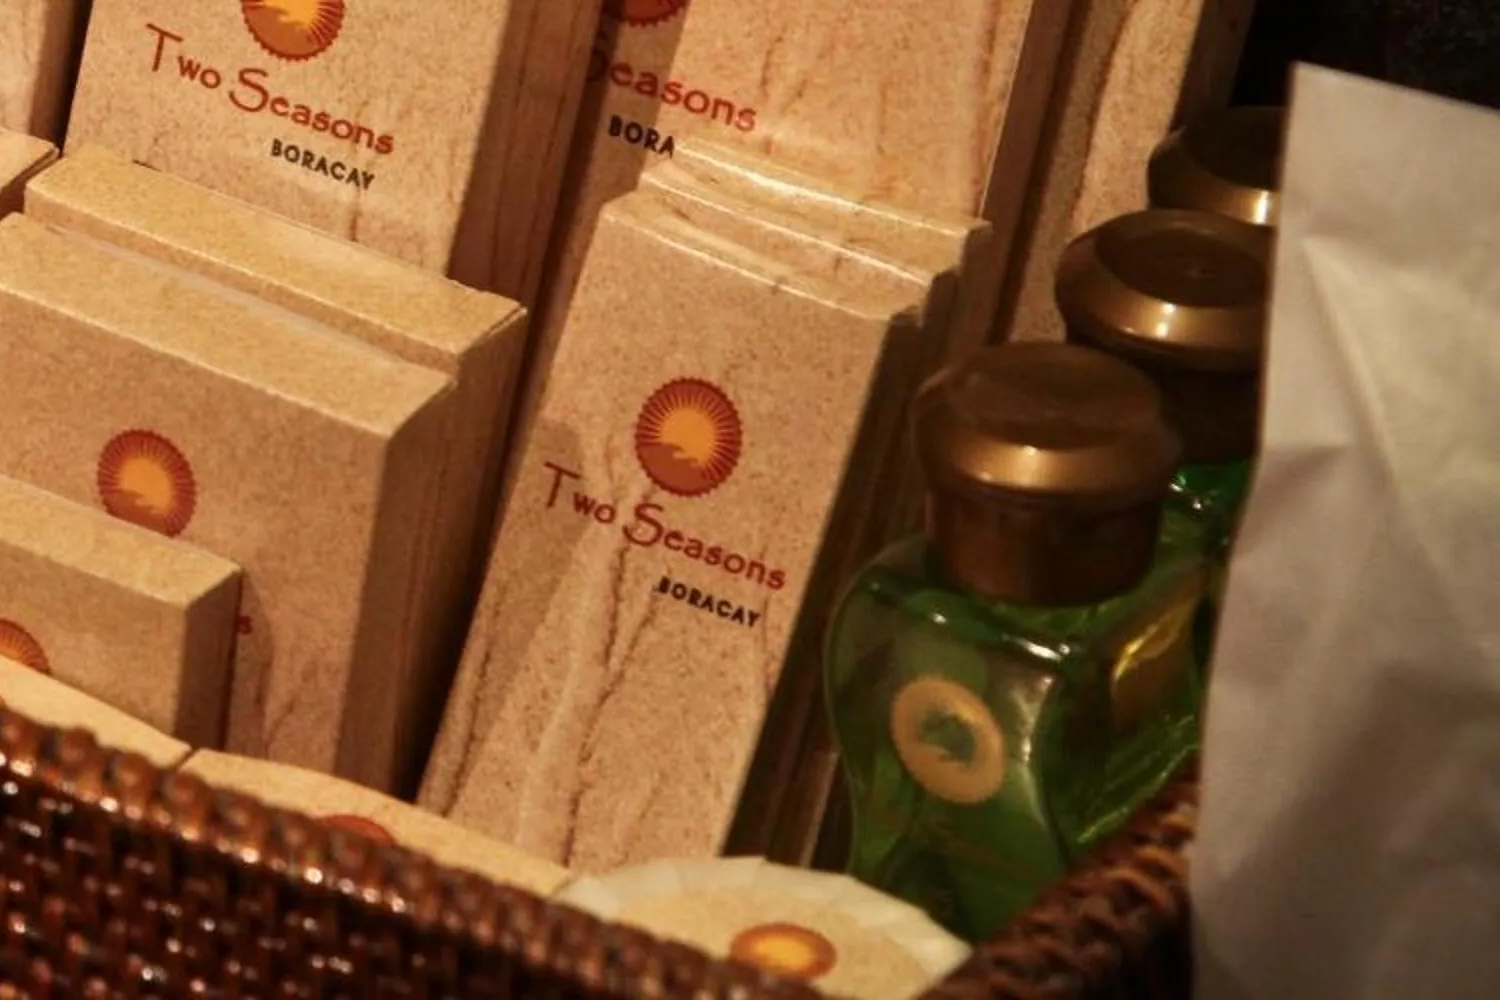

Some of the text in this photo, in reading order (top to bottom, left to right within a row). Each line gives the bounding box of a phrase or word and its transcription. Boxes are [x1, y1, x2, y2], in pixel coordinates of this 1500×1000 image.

[145, 23, 395, 155] Two Seasons
[609, 114, 676, 158] BORA
[270, 138, 376, 190] BORACAY
[544, 461, 786, 590] Two Seasons
[657, 576, 762, 629] BORACAY
